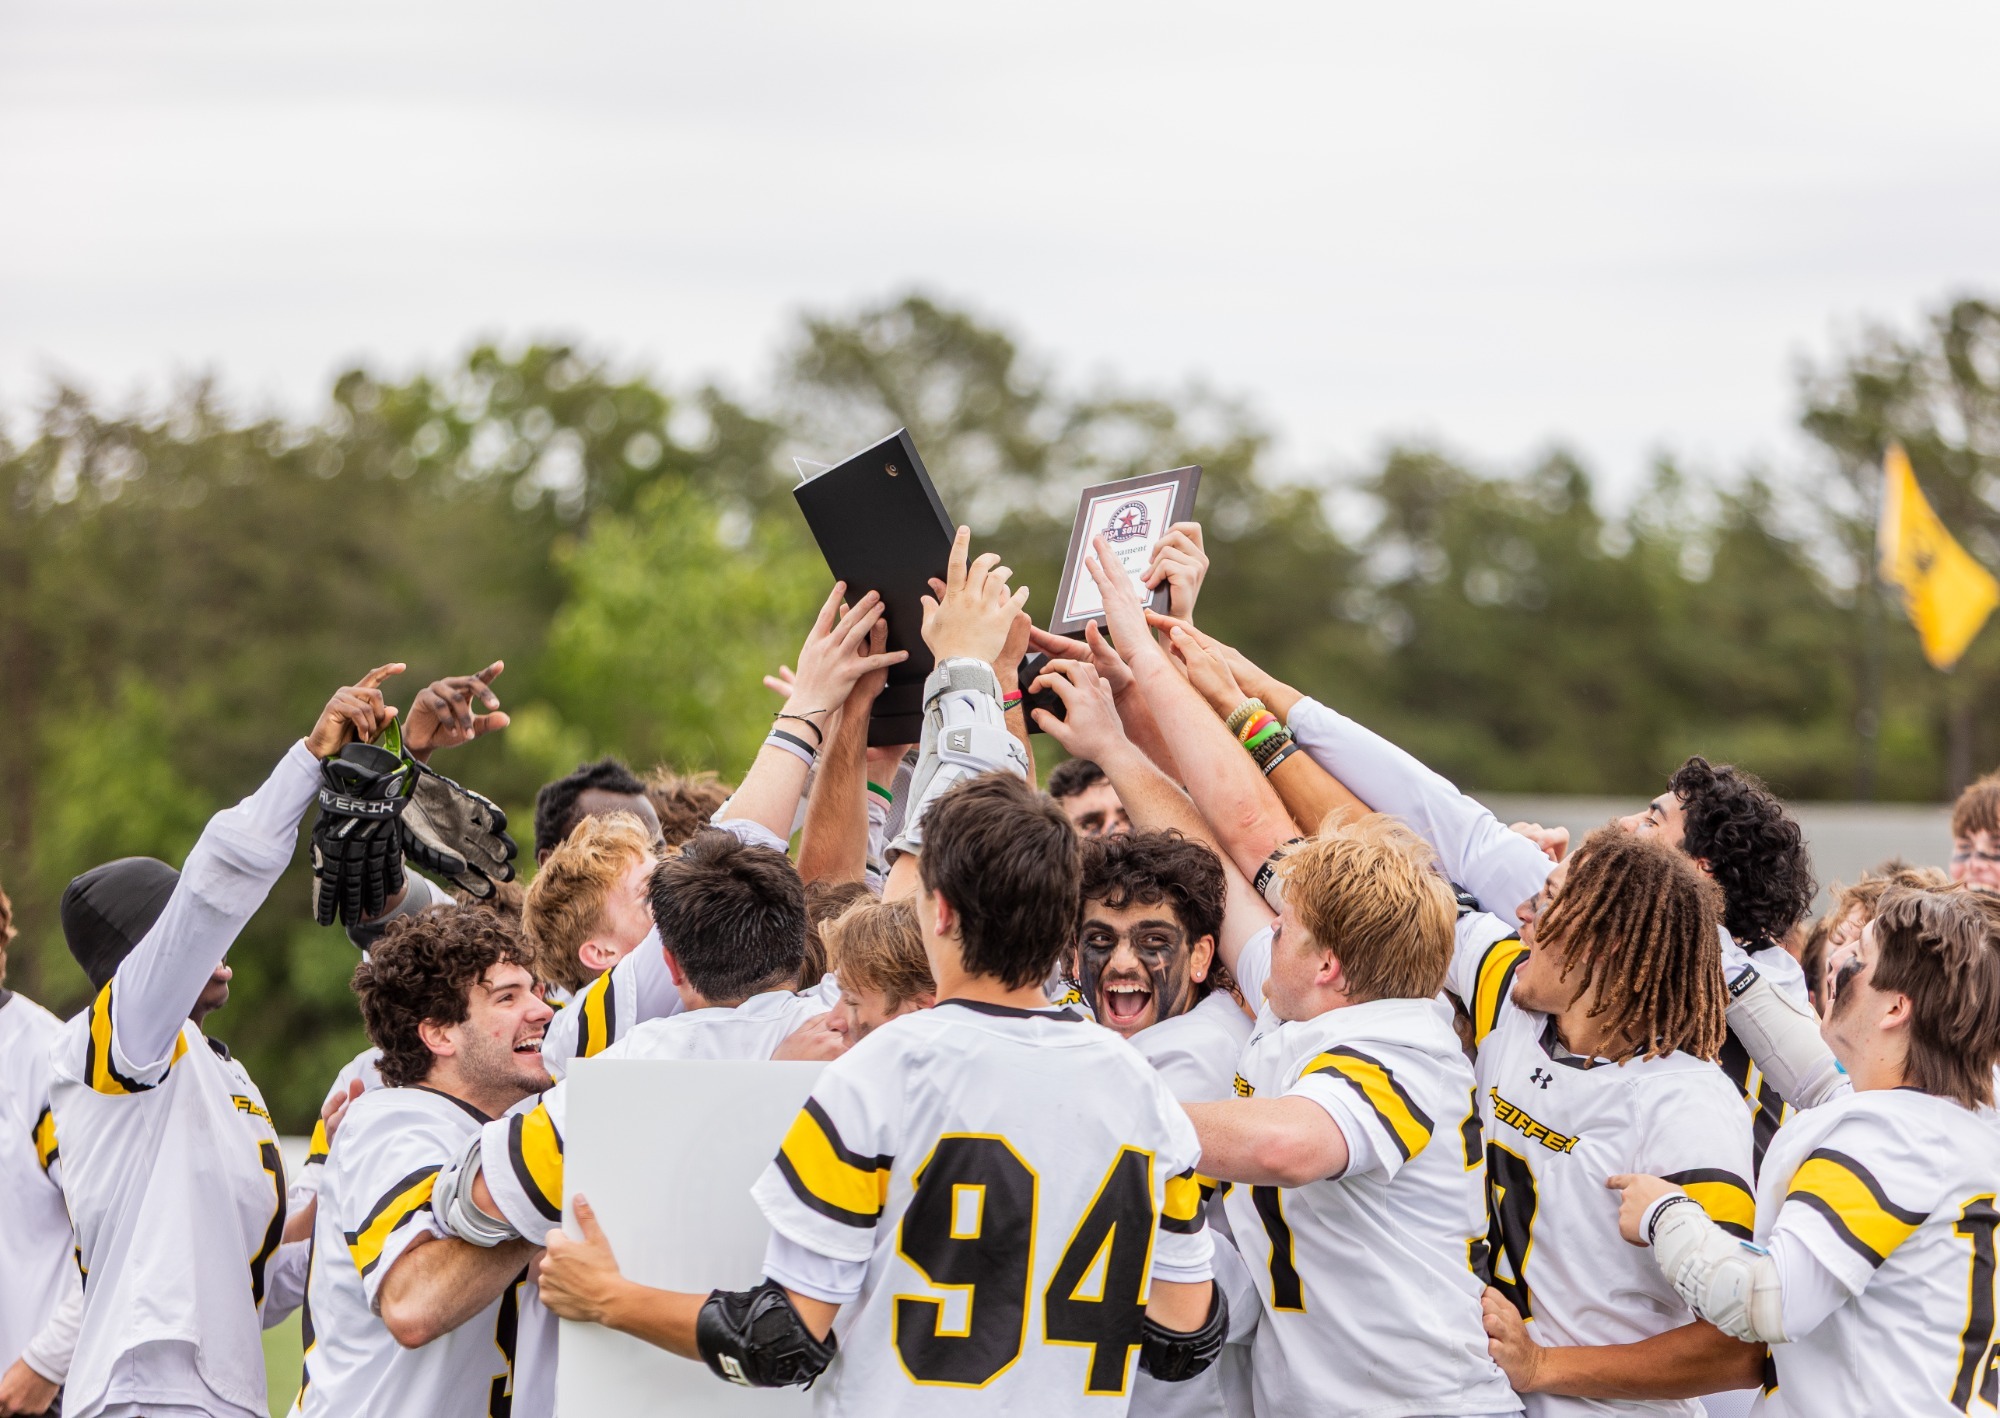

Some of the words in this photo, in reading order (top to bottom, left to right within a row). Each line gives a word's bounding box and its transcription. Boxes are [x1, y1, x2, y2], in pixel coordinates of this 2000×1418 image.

[1121, 523, 1148, 535] SOUTH
[319, 789, 394, 813] AVERIK
[1257, 863, 1276, 896] G-FOR
[892, 1132, 1156, 1397] 94
[1950, 1193, 2000, 1418] 1
